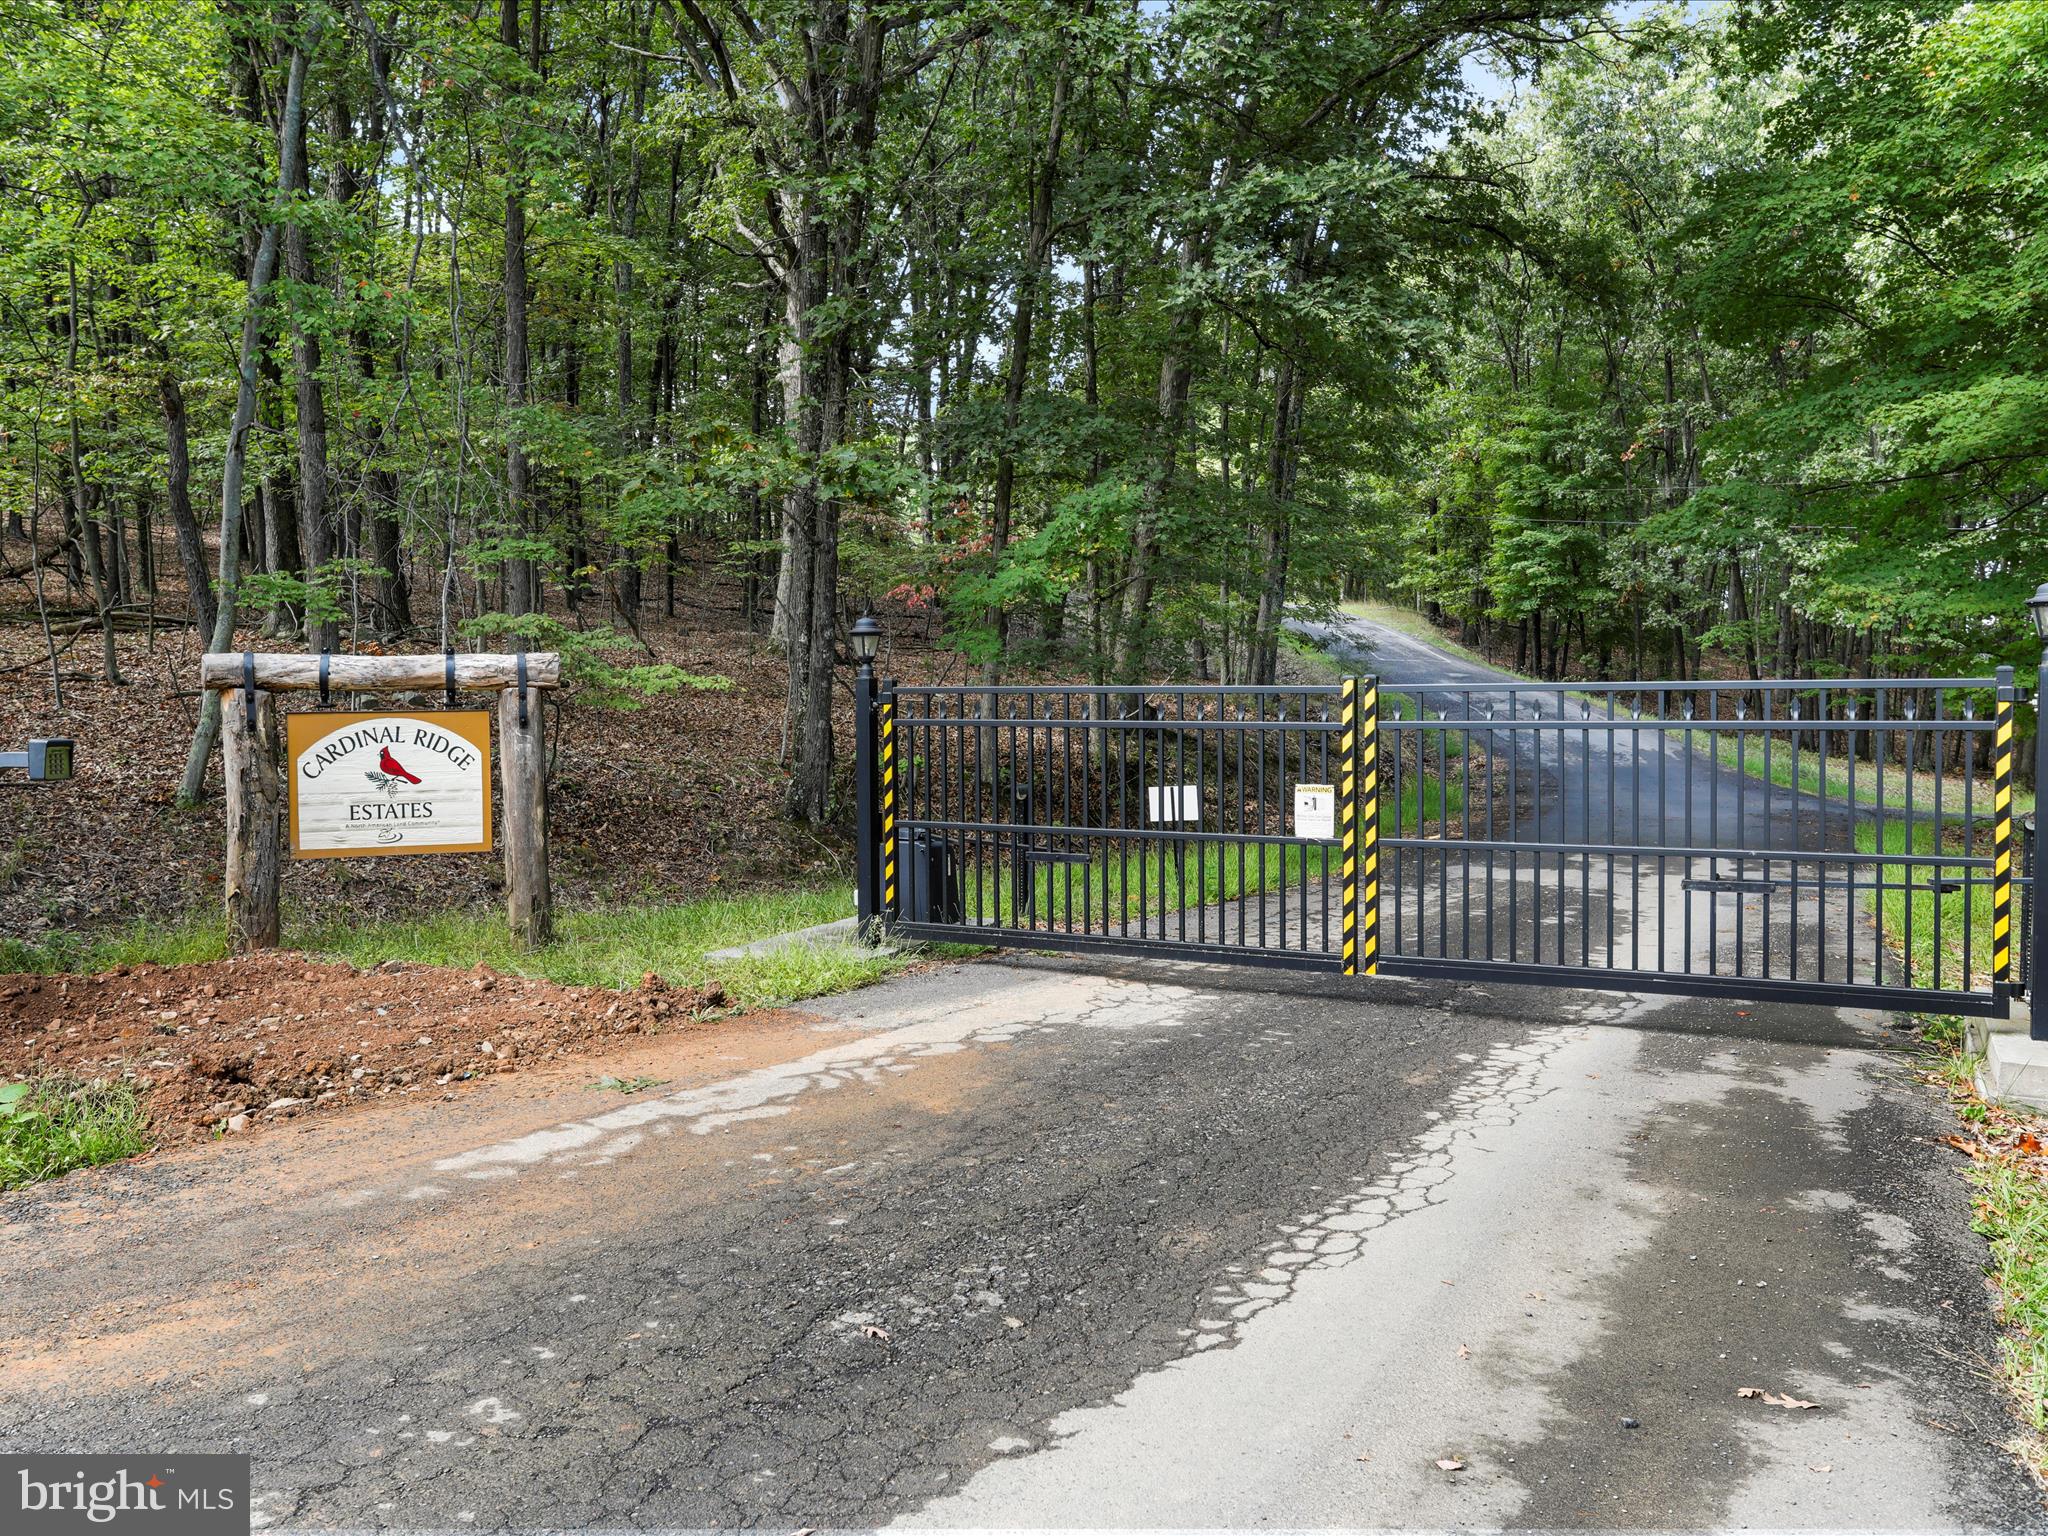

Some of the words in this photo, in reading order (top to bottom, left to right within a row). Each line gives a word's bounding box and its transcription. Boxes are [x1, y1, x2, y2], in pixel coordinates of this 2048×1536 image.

[302, 726, 406, 779] CARDINAL
[413, 728, 476, 771] RIDGE
[350, 801, 433, 821] ESTATES
